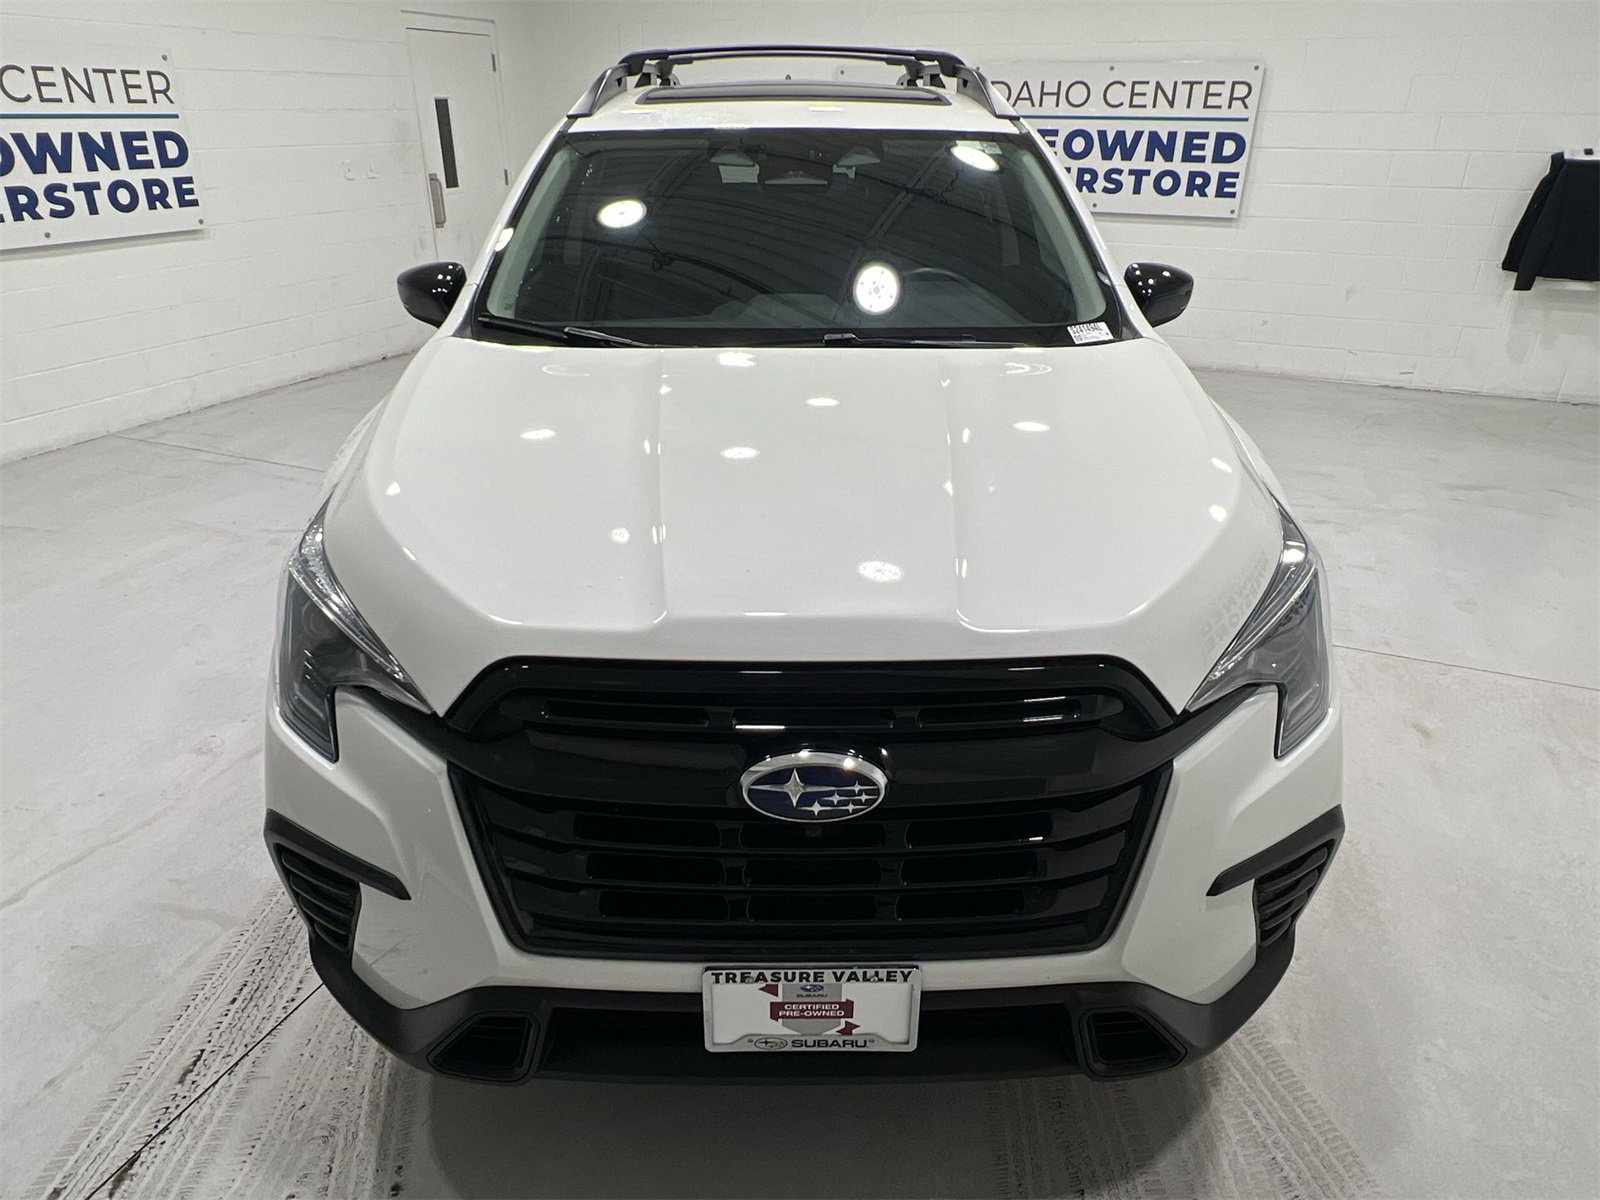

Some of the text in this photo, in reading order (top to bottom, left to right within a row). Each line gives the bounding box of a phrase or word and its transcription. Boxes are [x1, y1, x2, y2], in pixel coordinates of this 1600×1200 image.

[0, 64, 175, 104] CENTER
[1102, 80, 1253, 110] CENTER
[1065, 167, 1240, 198] RSTORE
[0, 176, 200, 223] RSTORE
[711, 970, 913, 984] TREASURE VALLEY
[791, 1039, 867, 1049] SUBARU
